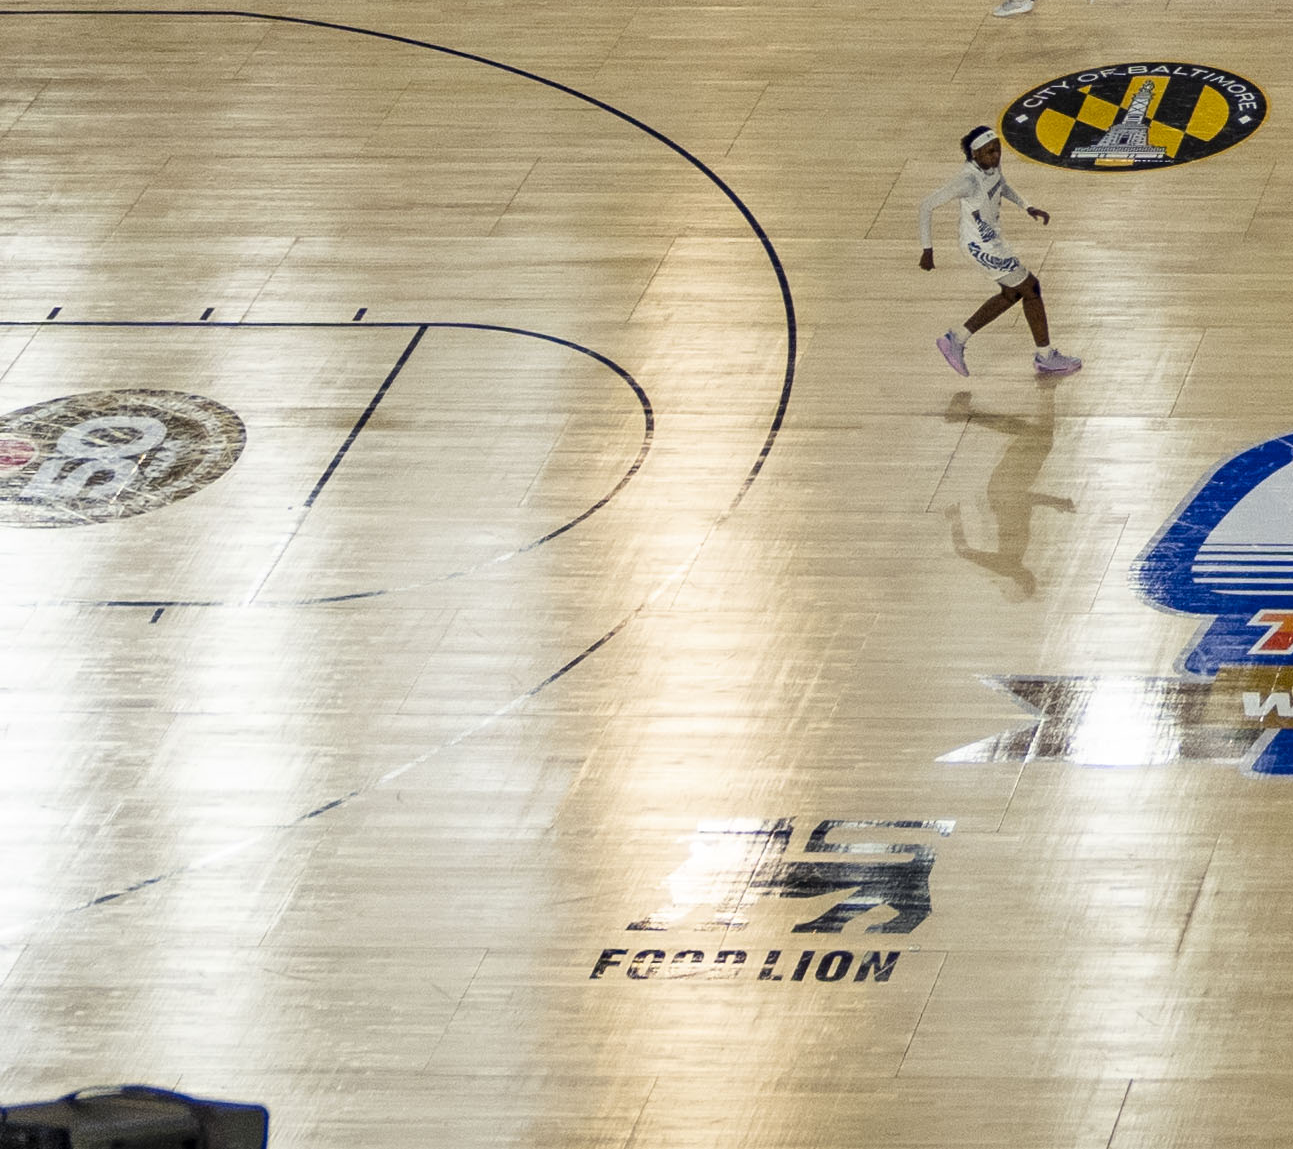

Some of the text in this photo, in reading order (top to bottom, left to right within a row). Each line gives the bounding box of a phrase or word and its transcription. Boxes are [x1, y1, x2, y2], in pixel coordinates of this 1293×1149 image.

[1022, 64, 1258, 111] CITY OF BALTIMORE
[757, 950, 902, 983] LION
